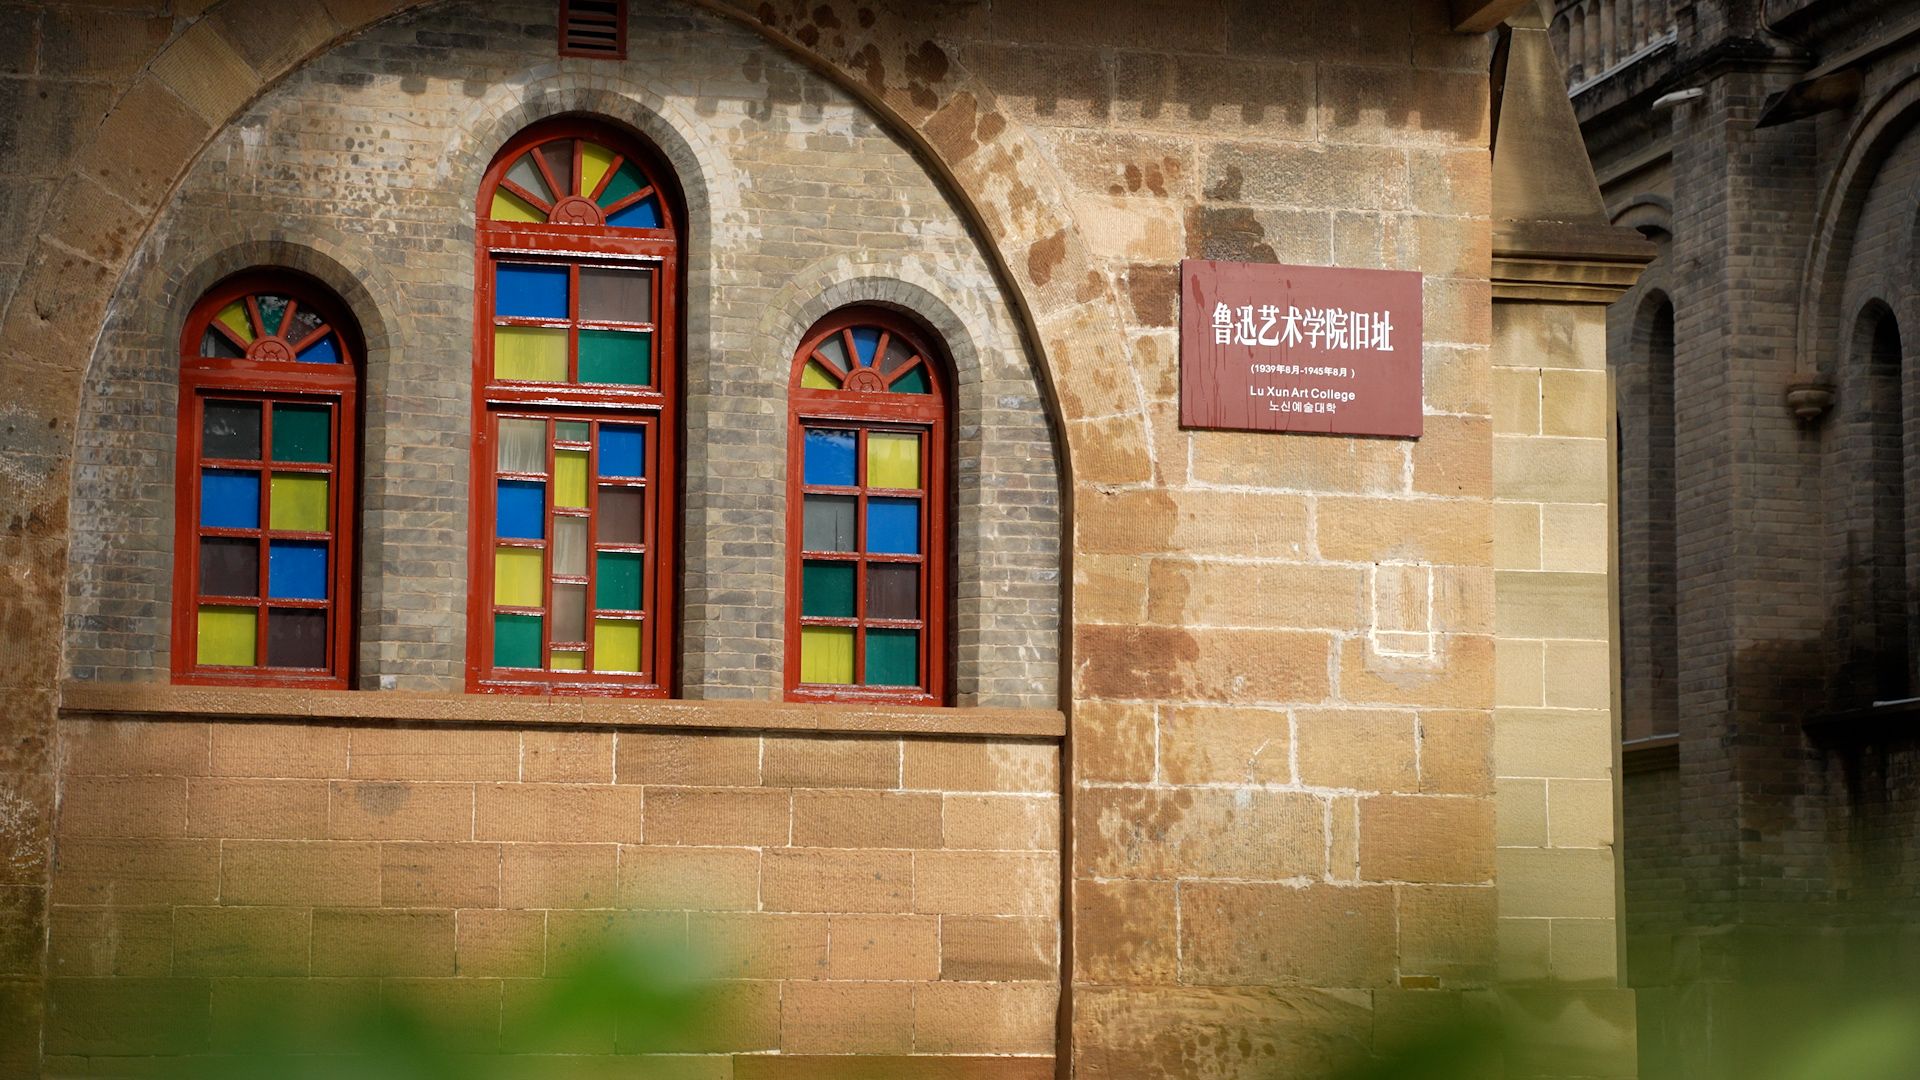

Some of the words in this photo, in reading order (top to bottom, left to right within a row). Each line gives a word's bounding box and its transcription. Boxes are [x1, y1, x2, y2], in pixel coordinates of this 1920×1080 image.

[1212, 301, 1394, 352] 鲁迅艺术学院旧址
[1250, 385, 1264, 396] Lu
[1267, 386, 1290, 397] Xun
[1291, 387, 1309, 398] Art
[1311, 388, 1356, 402] College
[1269, 400, 1337, 414] 노신예술대학
